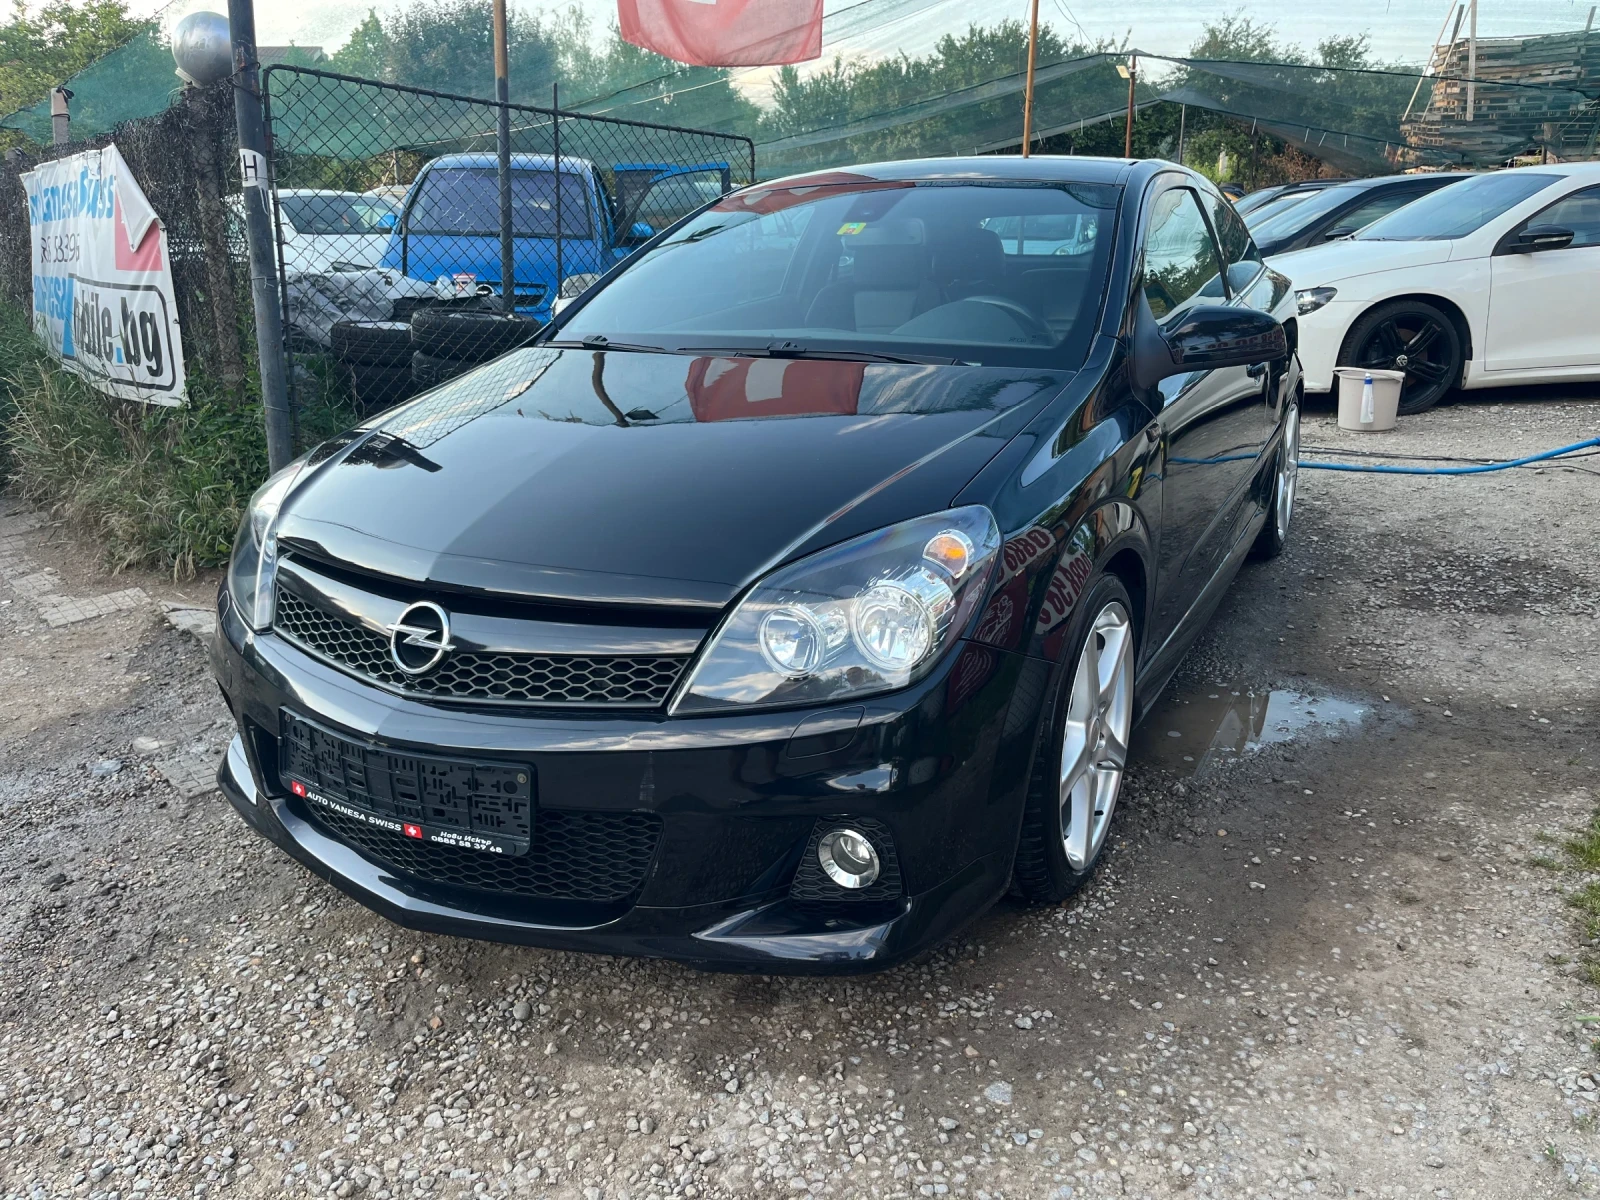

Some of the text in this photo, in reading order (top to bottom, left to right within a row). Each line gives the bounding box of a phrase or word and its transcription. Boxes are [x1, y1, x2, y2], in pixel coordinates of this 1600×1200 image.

[306, 791, 402, 832] AUTO VANESA SWISS
